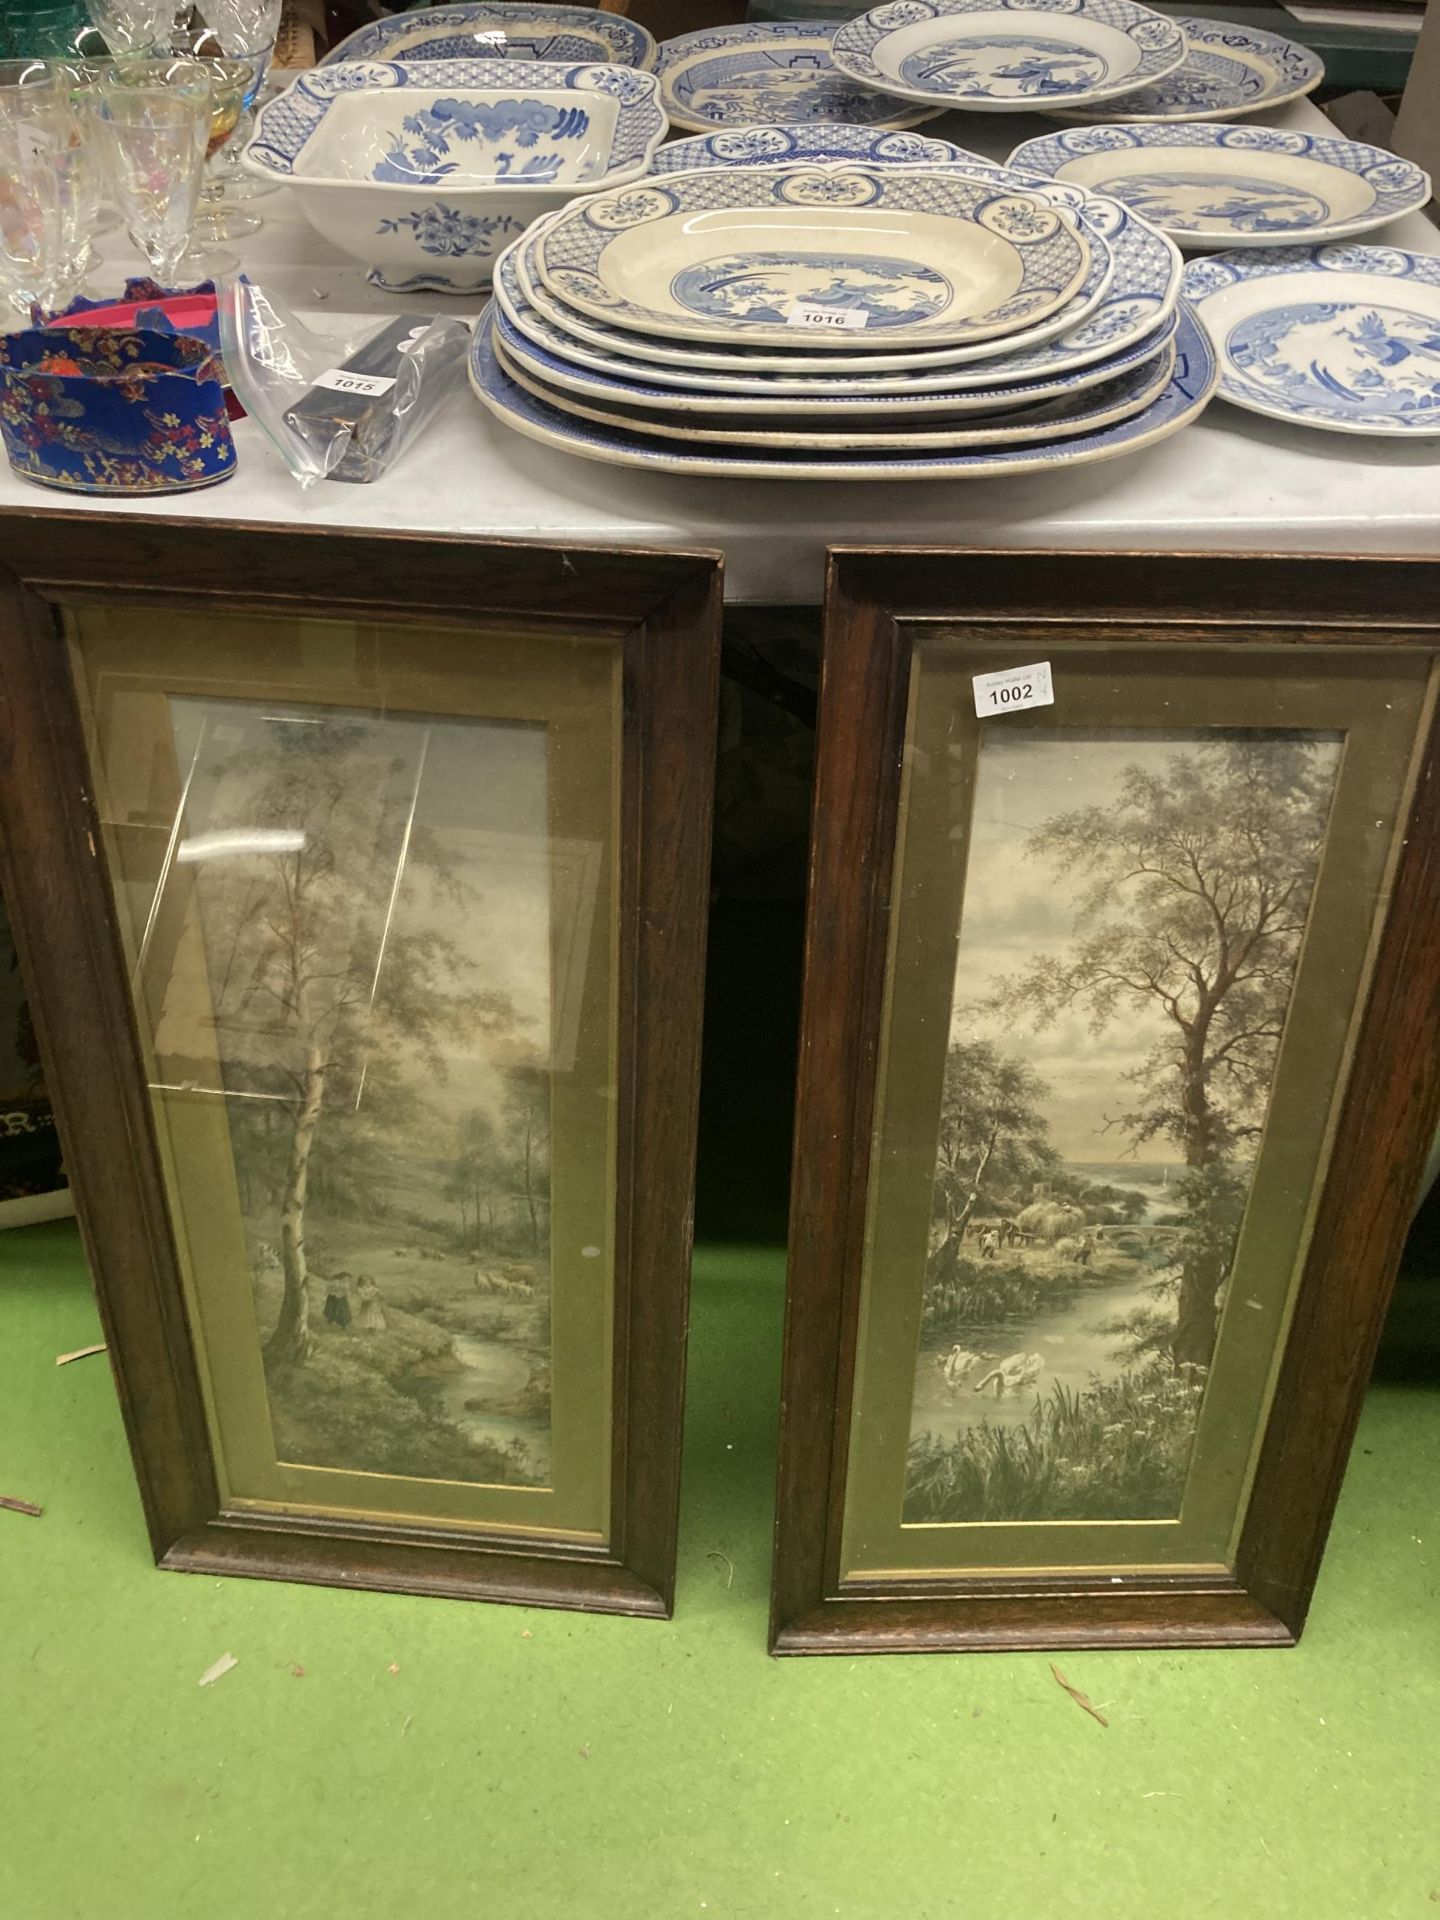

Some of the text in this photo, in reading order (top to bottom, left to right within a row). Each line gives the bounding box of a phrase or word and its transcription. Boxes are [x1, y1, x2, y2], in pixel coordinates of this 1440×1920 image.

[802, 314, 846, 325] 1016
[334, 379, 376, 391] 1015
[989, 684, 1033, 705] 1002
